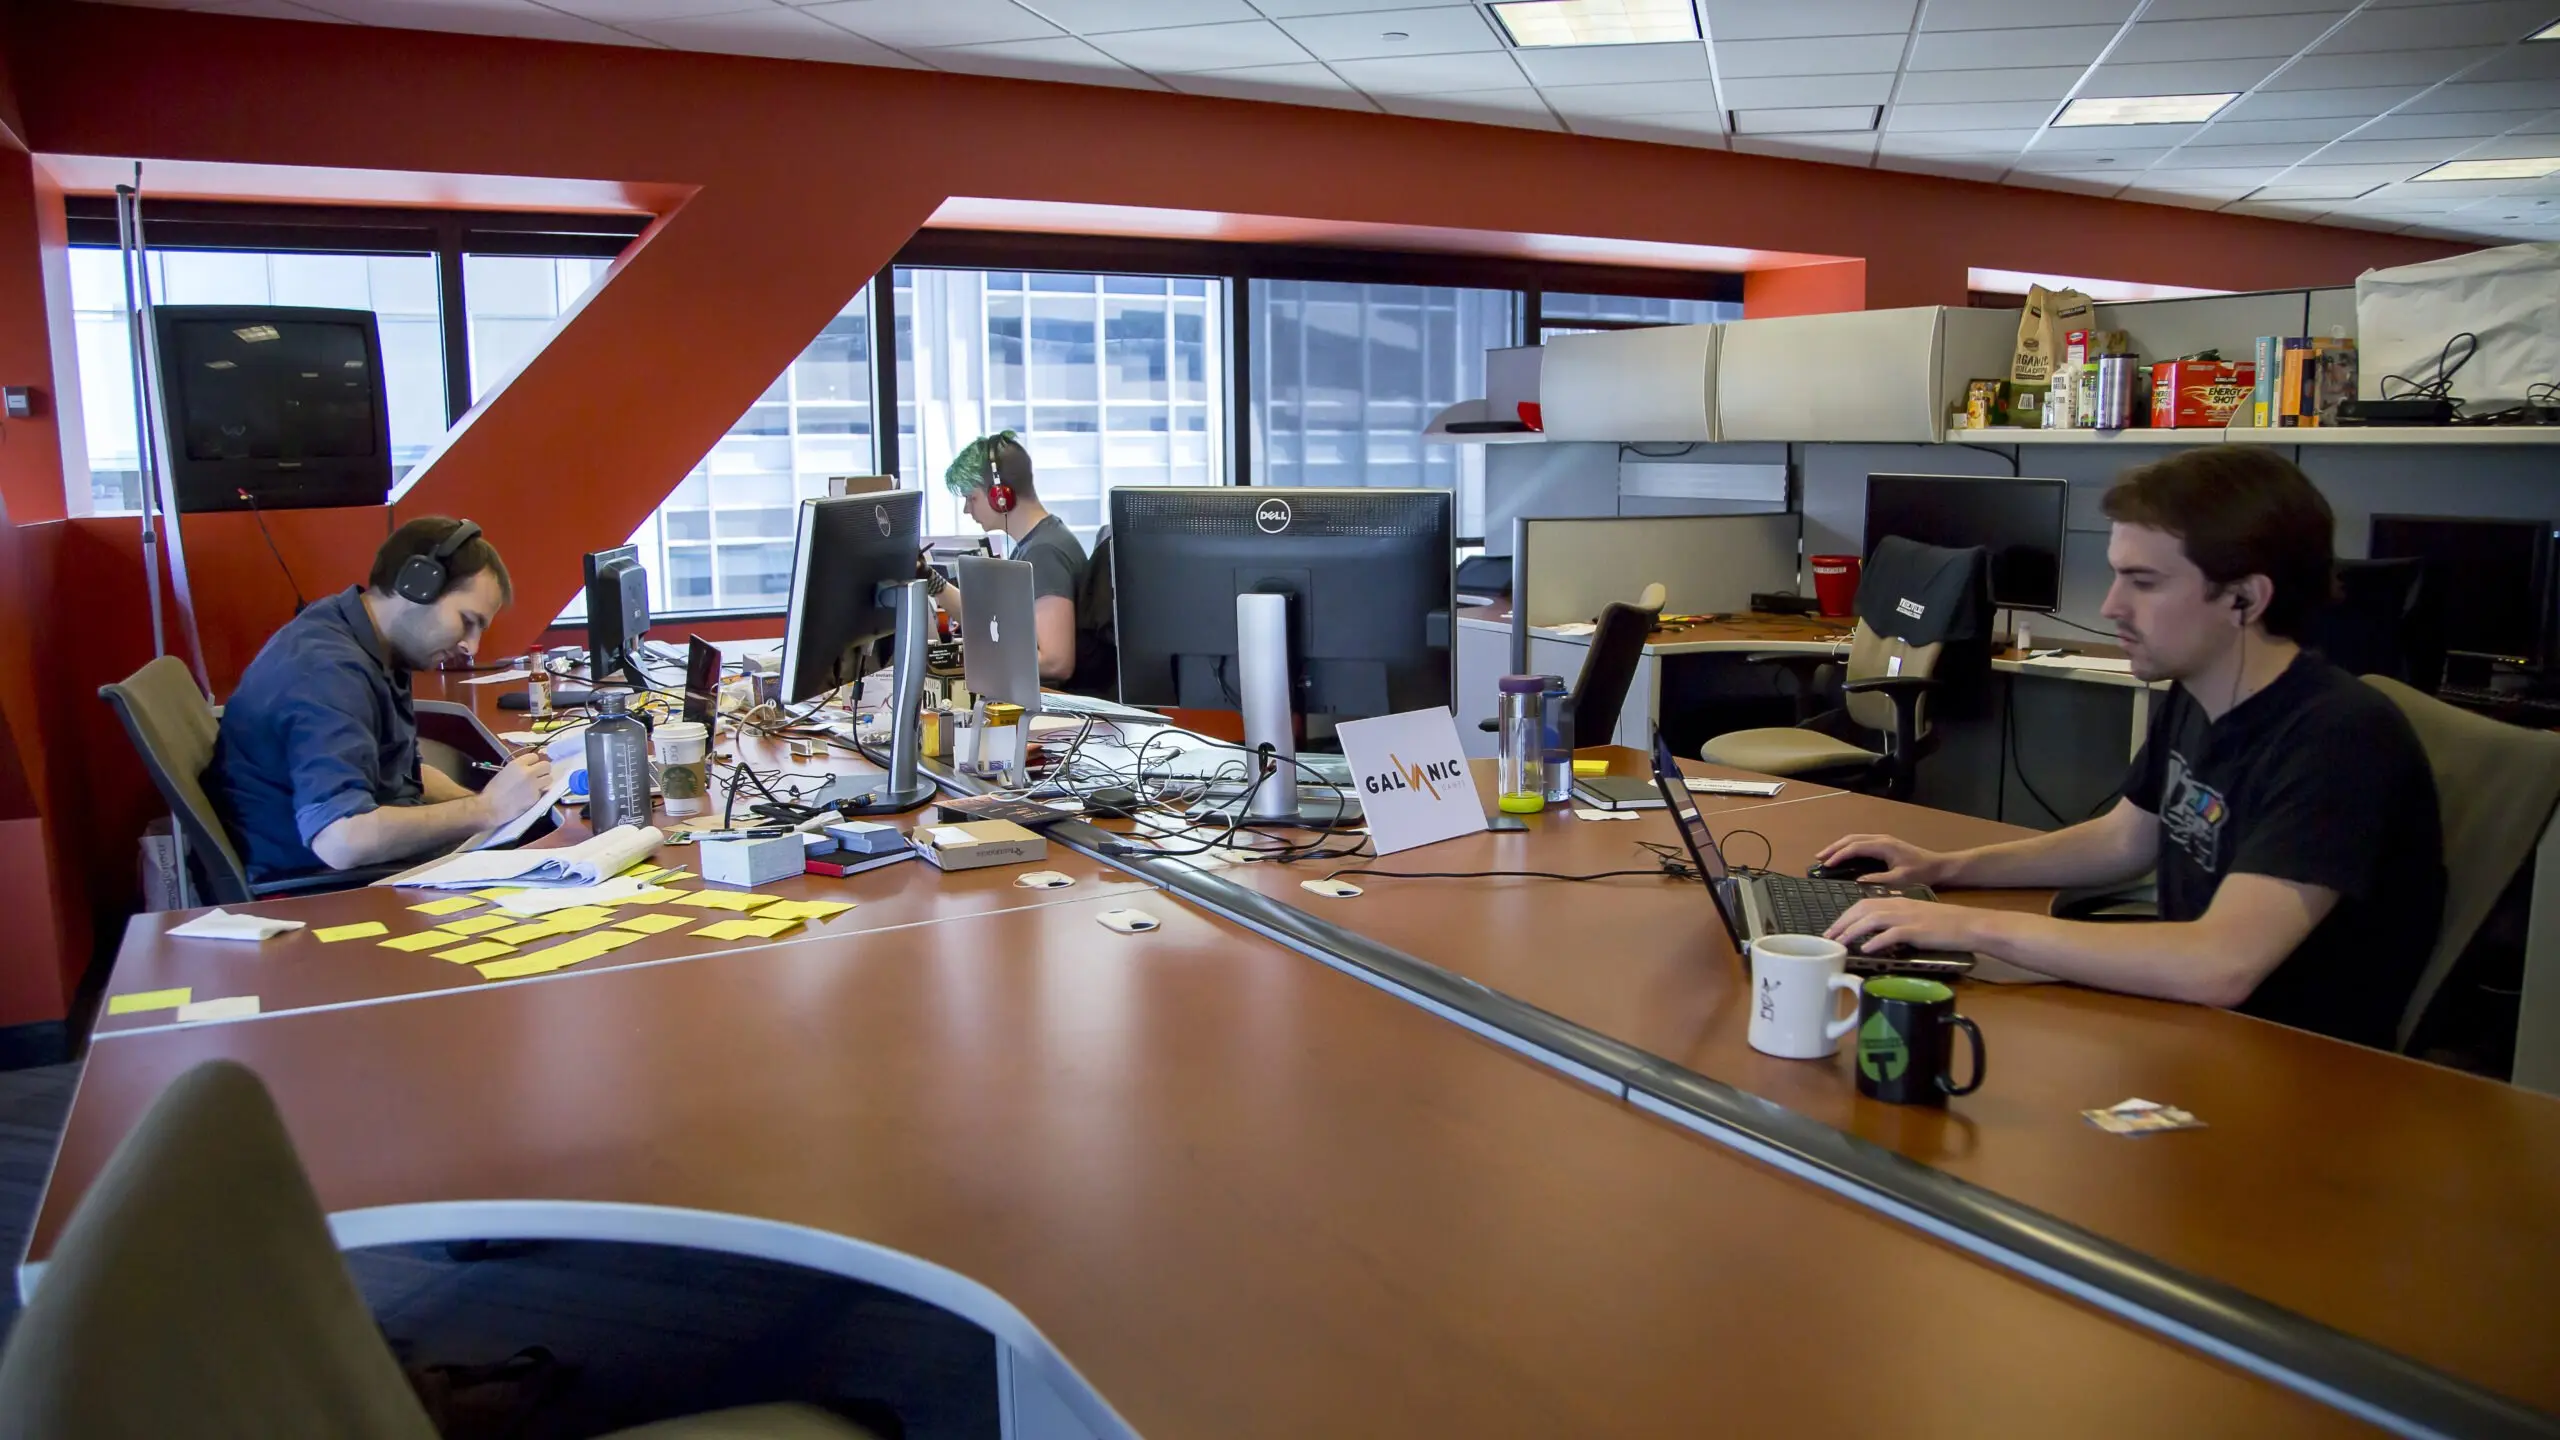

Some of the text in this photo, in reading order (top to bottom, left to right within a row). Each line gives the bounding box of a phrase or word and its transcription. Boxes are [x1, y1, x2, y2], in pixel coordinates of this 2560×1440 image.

[2016, 354, 2048, 367] RGANIC
[2208, 387, 2242, 396] ENERGY
[2212, 395, 2236, 405] SHOT
[1260, 511, 1287, 520] DELL
